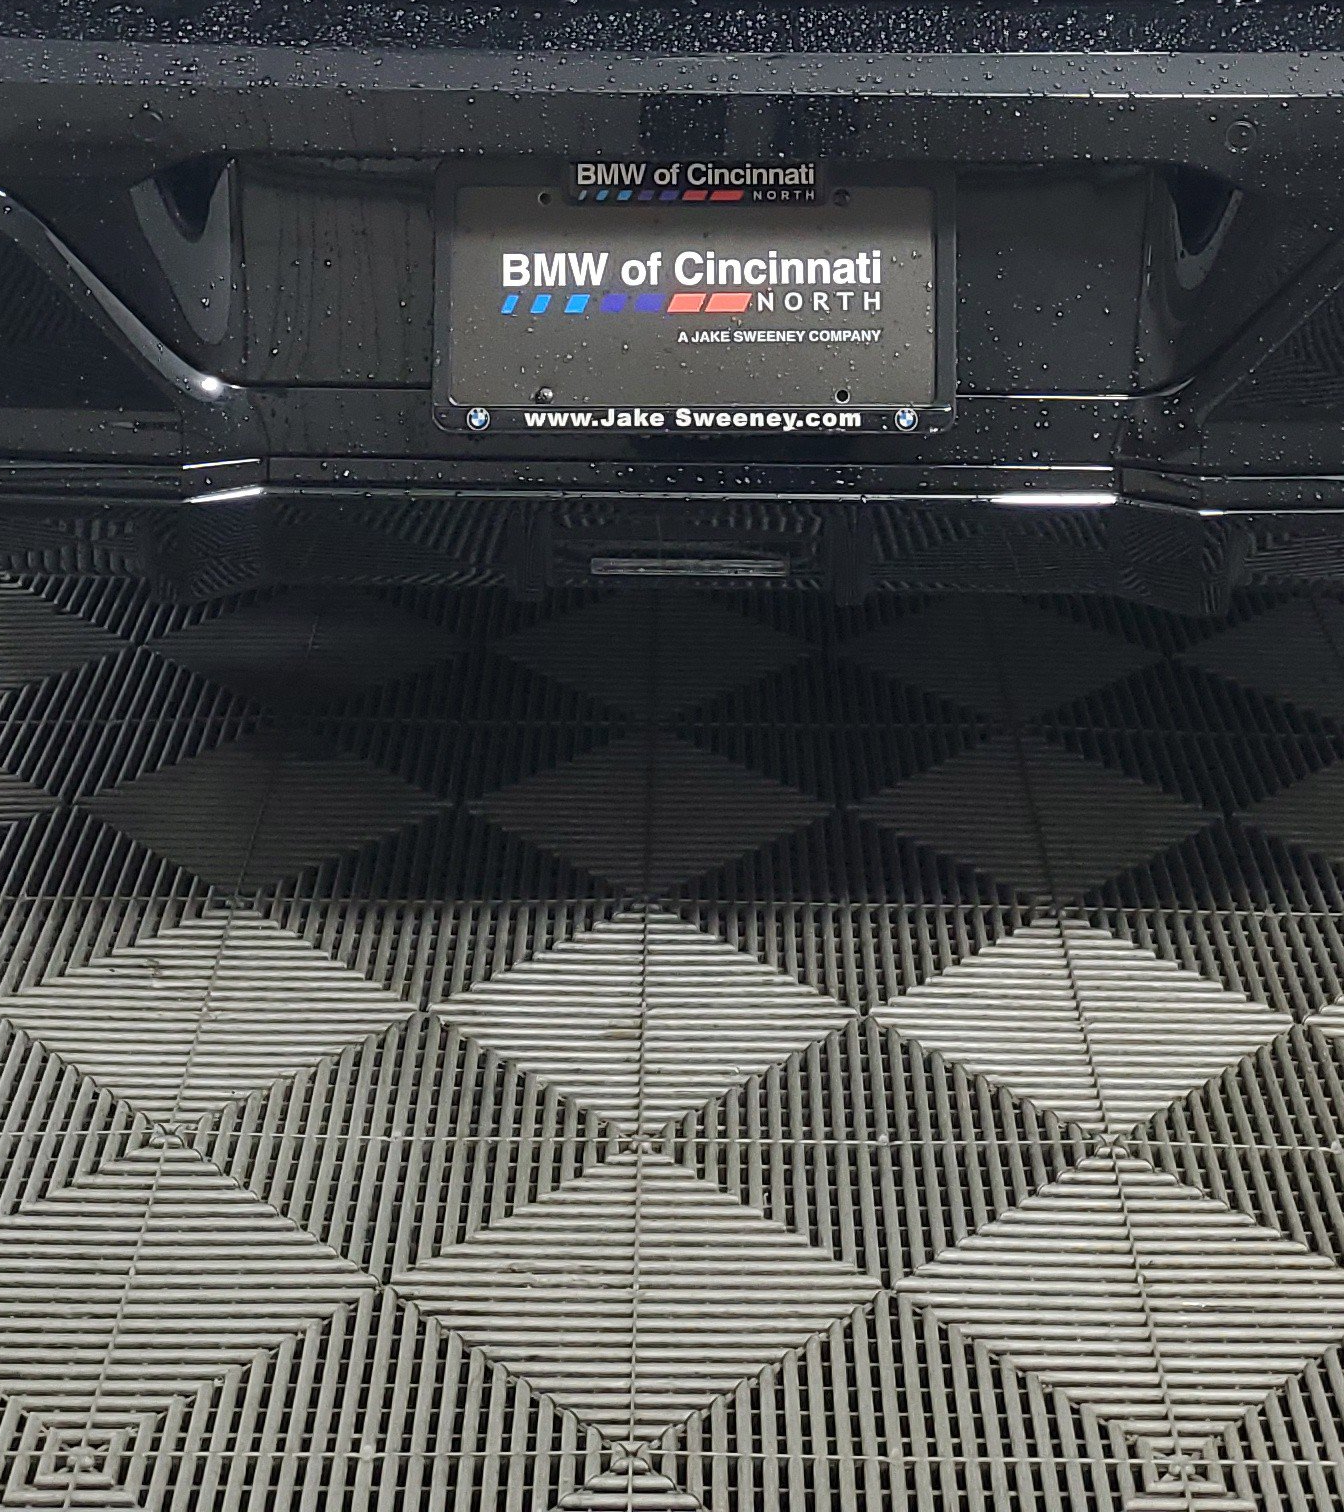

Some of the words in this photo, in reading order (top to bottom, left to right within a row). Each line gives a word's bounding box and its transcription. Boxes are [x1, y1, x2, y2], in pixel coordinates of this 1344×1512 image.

[577, 164, 645, 185] BMW
[654, 163, 681, 185] of
[687, 163, 815, 185] Cincinnati
[753, 190, 815, 201] NORTH
[502, 253, 608, 286] BMW
[621, 252, 662, 286] of
[674, 250, 881, 285] Cincinnati
[758, 292, 881, 312] NORTH
[677, 331, 689, 343] A
[692, 331, 731, 343] JAKE
[733, 330, 805, 343] SWEENEY
[808, 330, 881, 343] COMPANY
[524, 408, 665, 427] www.Jake
[675, 408, 861, 431] Sweeney.com
